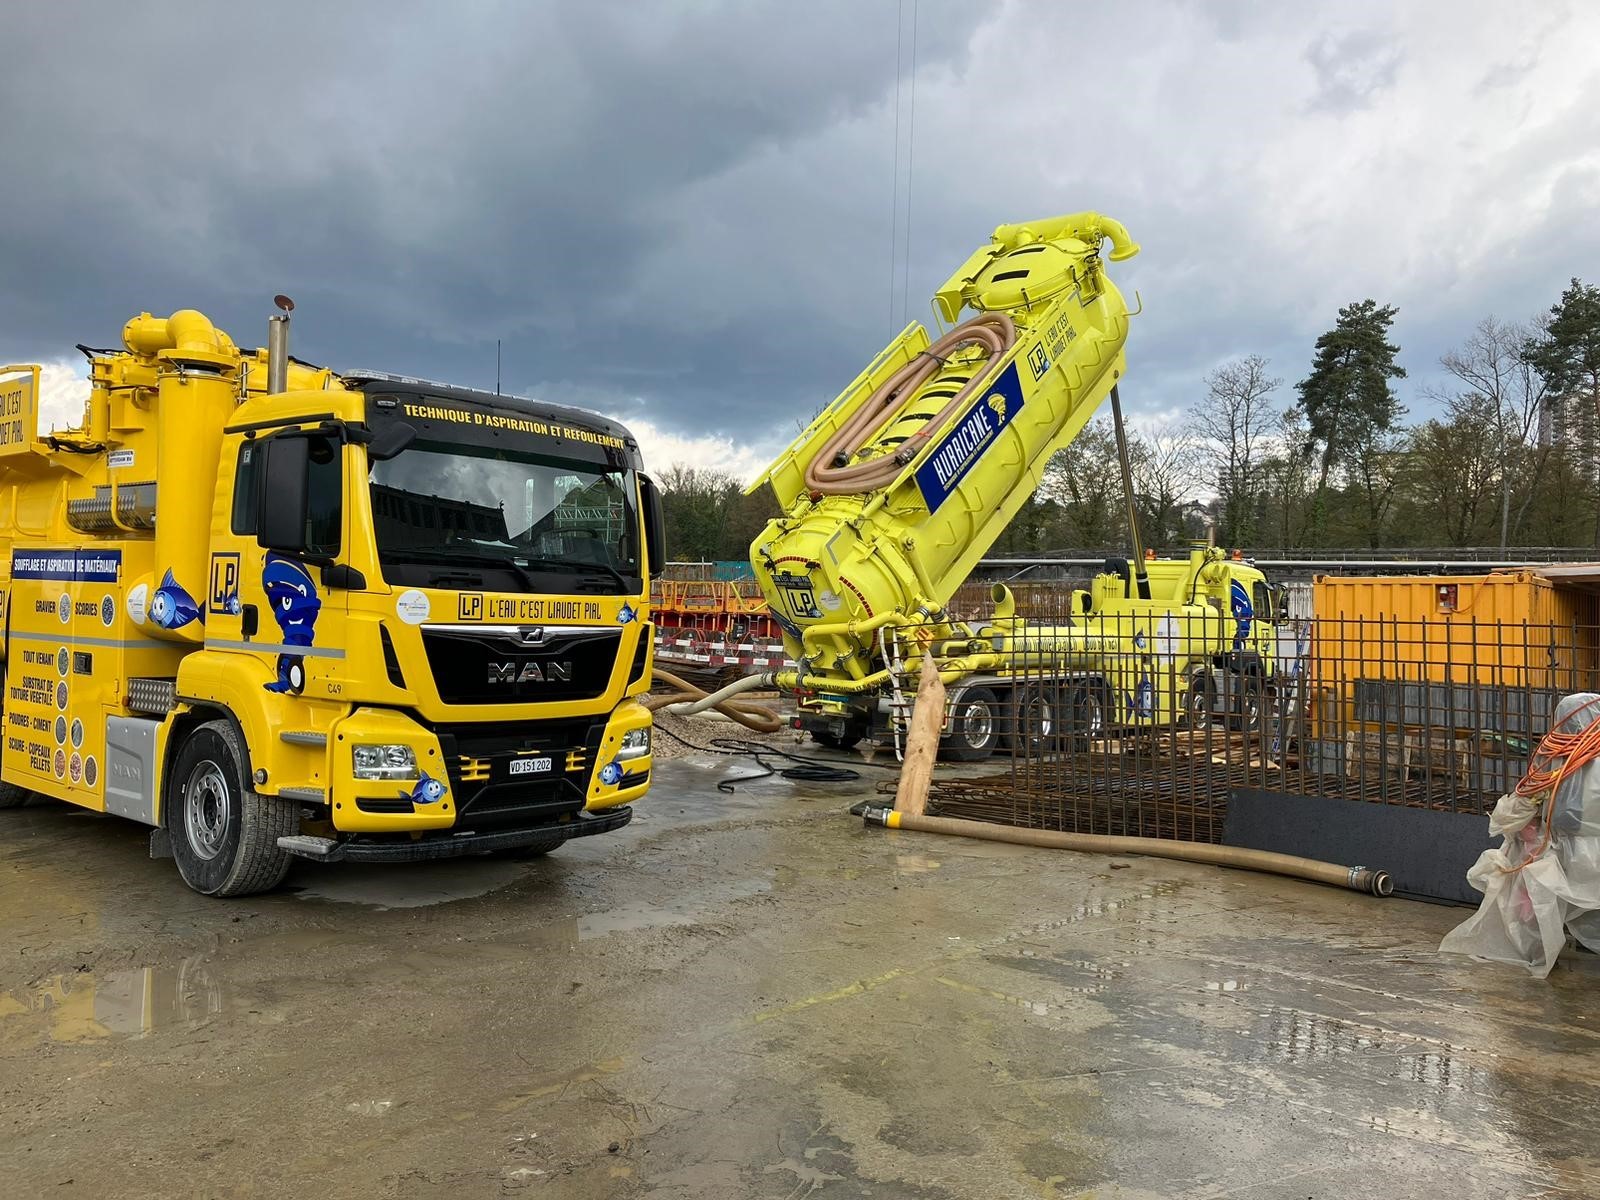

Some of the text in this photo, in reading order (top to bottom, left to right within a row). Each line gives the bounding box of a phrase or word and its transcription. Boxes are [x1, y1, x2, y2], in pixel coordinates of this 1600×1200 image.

[1031, 348, 1044, 374] LP
[7, 390, 22, 415] C'EST
[0, 421, 11, 445] DET
[404, 404, 625, 450] TECHNIQUE D'ASPIRATION ET REFOULEMENT
[933, 405, 991, 485] HURRICANE
[14, 556, 117, 573] SOUFFLAGE ET ASPIRATION DE MATÉRIAUX
[214, 562, 236, 604] LP
[36, 600, 56, 613] GRAVIER
[75, 602, 98, 616] SCORIES
[461, 596, 602, 620] LP L'EAU C'EST LIAUDET PIAL
[789, 592, 811, 615] LP
[23, 650, 54, 666] TOUT VENANT
[488, 662, 572, 683] MAN
[22, 676, 53, 692] SUBSTRAT DE
[327, 683, 342, 694] C49
[10, 687, 53, 706] TOITURE VEGETALE
[9, 712, 29, 727] POUDRES
[33, 717, 52, 732] CIMENT
[8, 737, 25, 751] SCIURE
[28, 742, 51, 758] COPEAUX
[30, 756, 51, 773] PELLETS
[511, 762, 520, 772] VD
